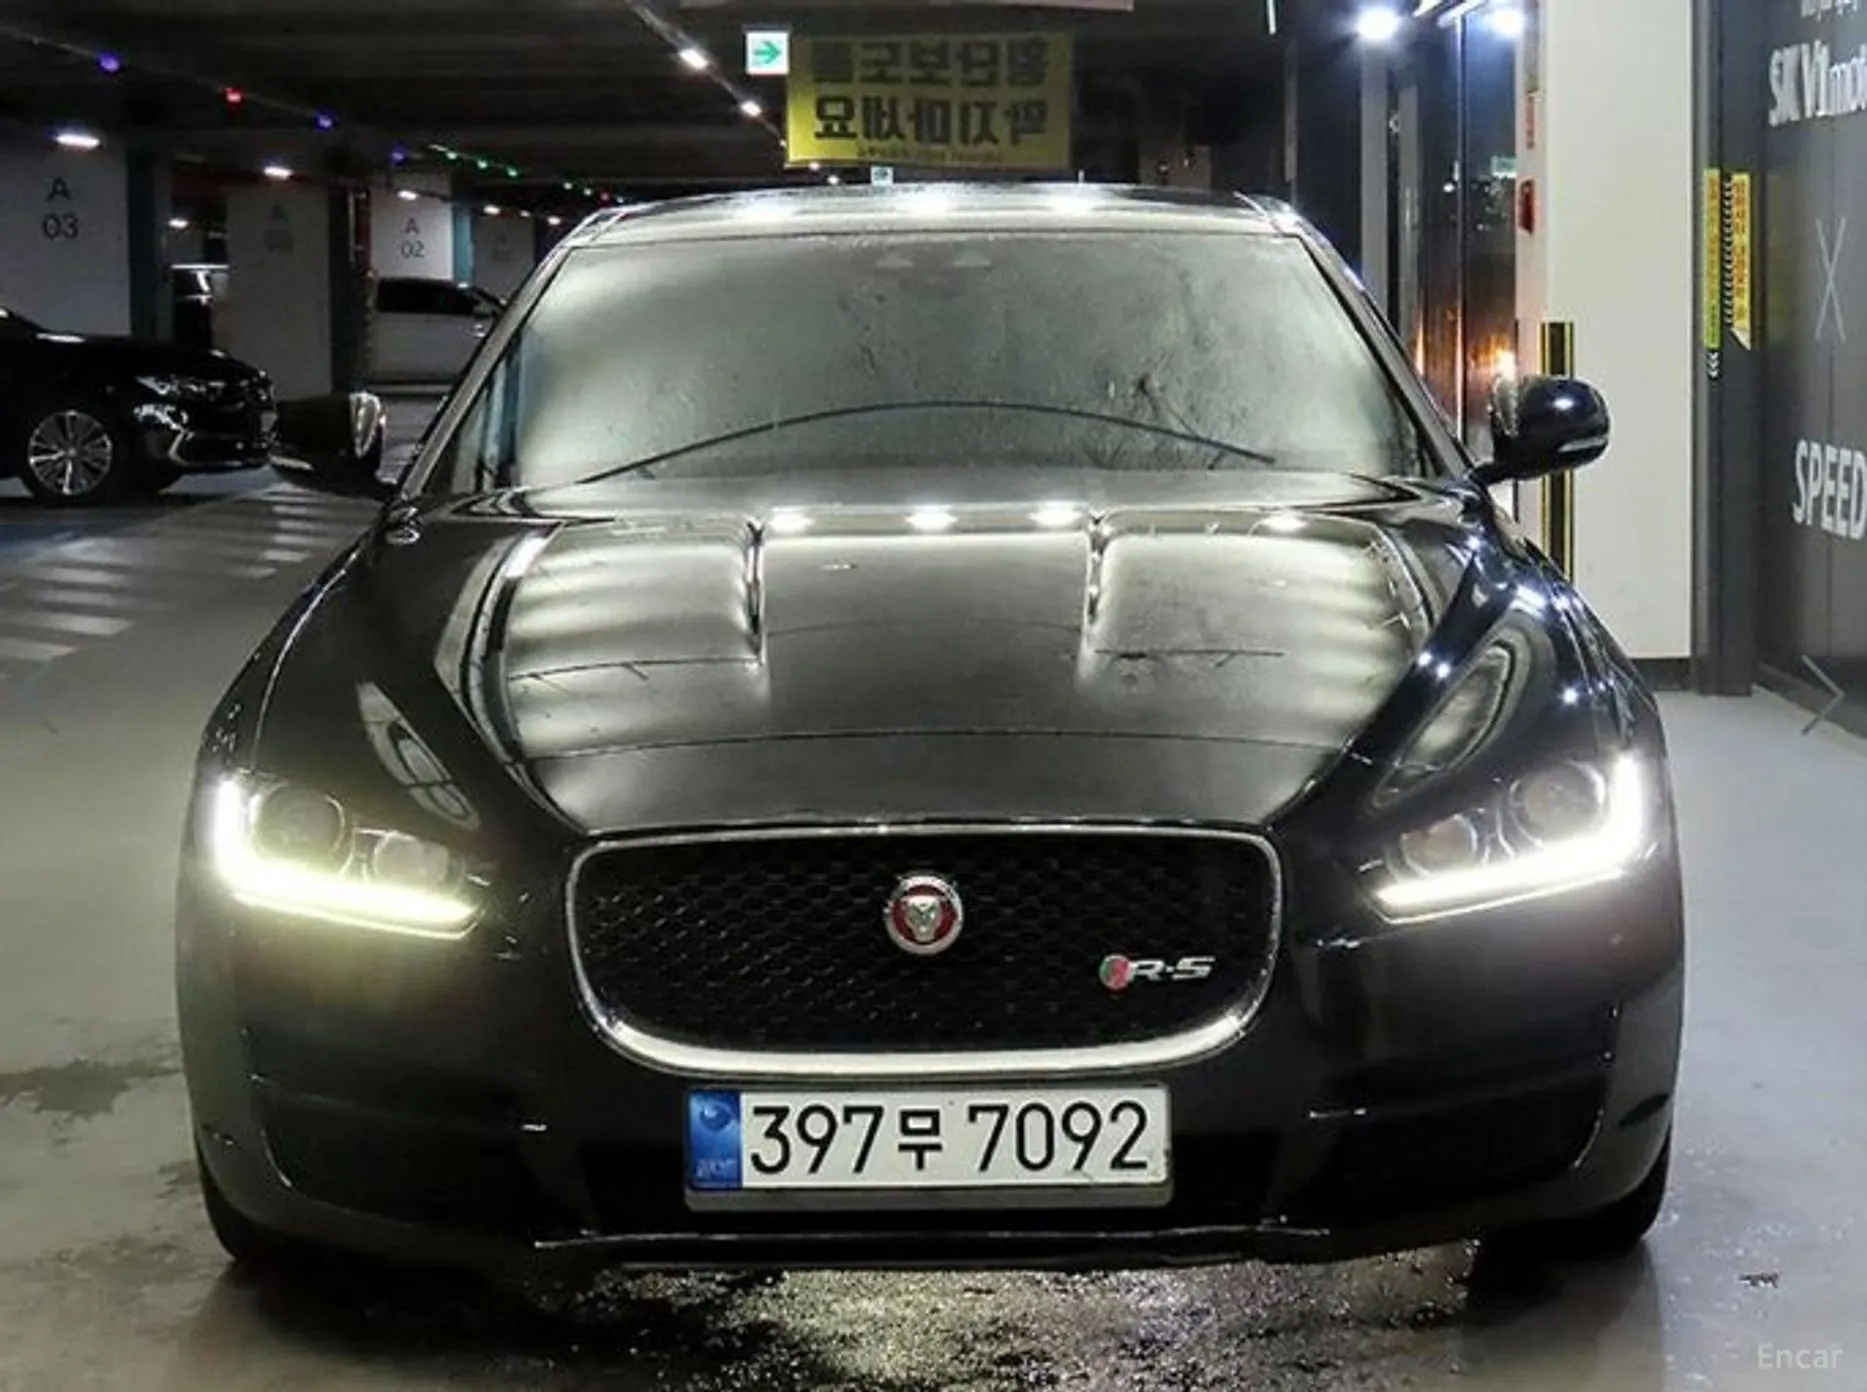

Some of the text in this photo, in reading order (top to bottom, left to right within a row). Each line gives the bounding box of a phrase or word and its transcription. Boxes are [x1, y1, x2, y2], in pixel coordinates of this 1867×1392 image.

[46, 177, 71, 201] A
[42, 213, 79, 240] 03
[405, 217, 420, 234] A
[400, 240, 426, 258] 02
[1792, 439, 1867, 540] SPEED
[750, 1101, 1149, 1175] 397무 7092
